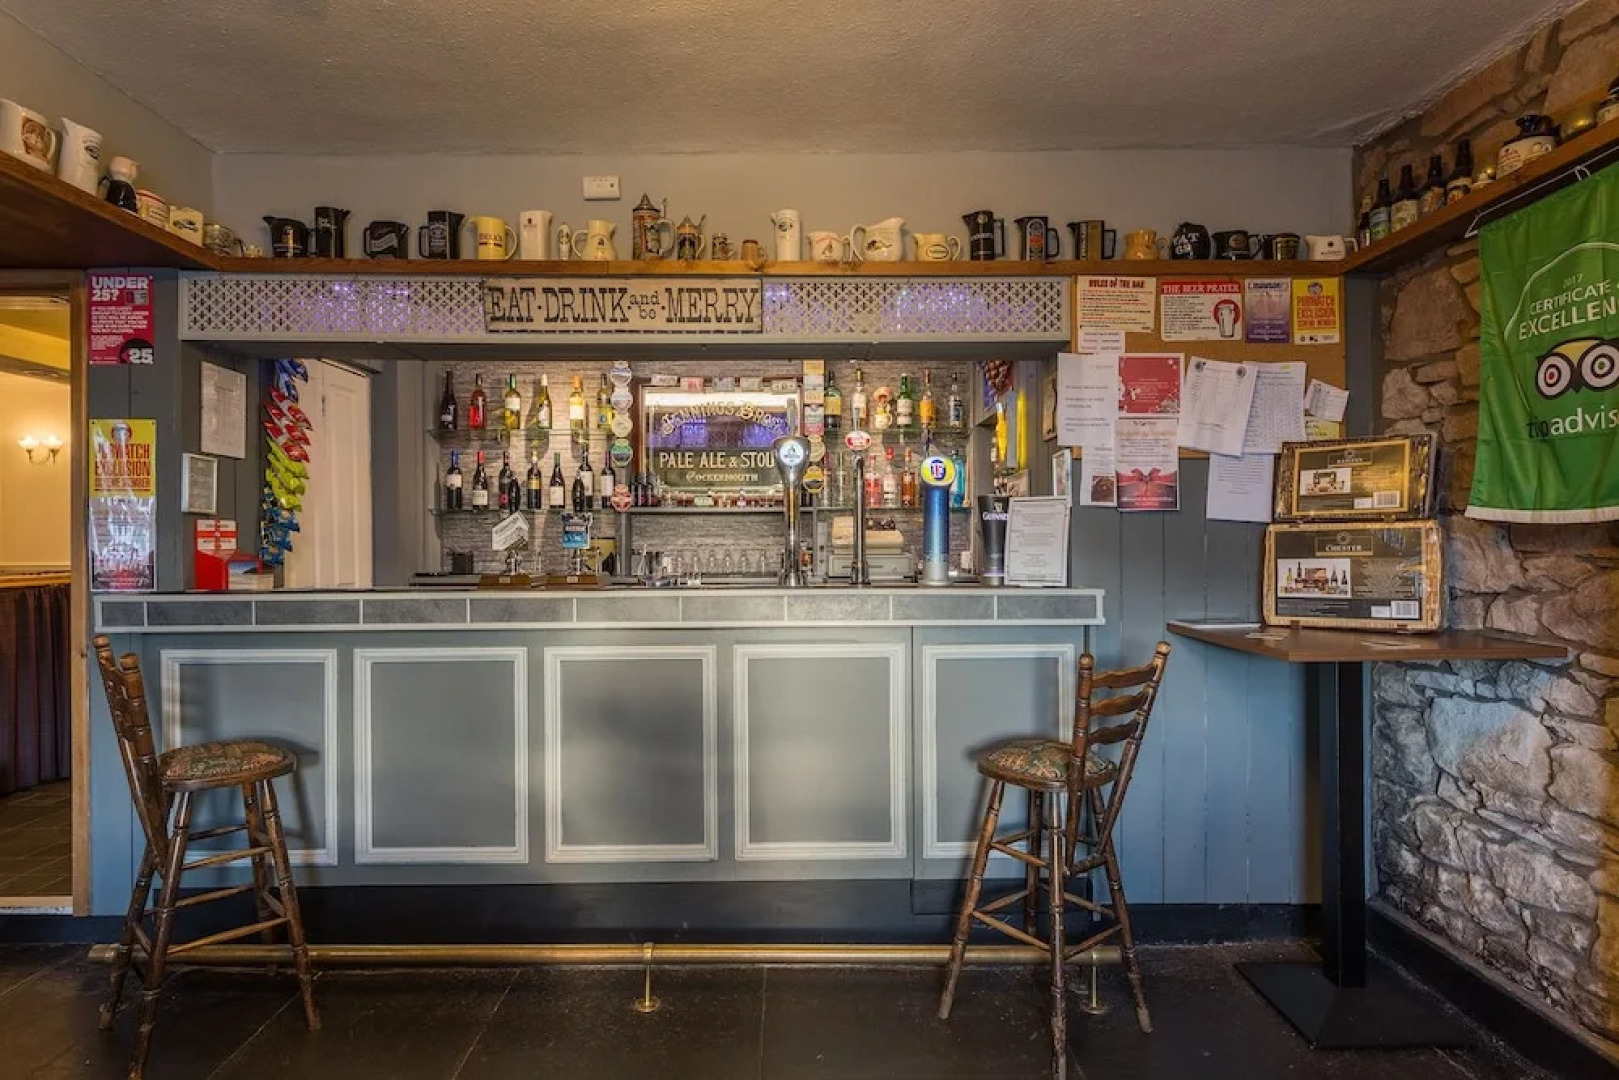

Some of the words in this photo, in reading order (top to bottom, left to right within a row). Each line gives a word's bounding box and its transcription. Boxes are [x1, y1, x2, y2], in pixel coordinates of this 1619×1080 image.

[91, 276, 149, 289] UNDER
[1162, 284, 1180, 294] THE
[1182, 284, 1205, 294] BEER
[91, 289, 119, 302] 25?
[629, 290, 660, 305] and
[1530, 279, 1612, 315] CERTIFICATE
[489, 287, 536, 323] EAT
[542, 287, 629, 323] DRINK
[665, 287, 759, 323] MERRY
[129, 348, 154, 364] 25
[95, 443, 150, 459] WATCH
[660, 451, 694, 469] PALE
[699, 451, 726, 469] ALE
[729, 456, 738, 468] &
[740, 451, 777, 469] STOU
